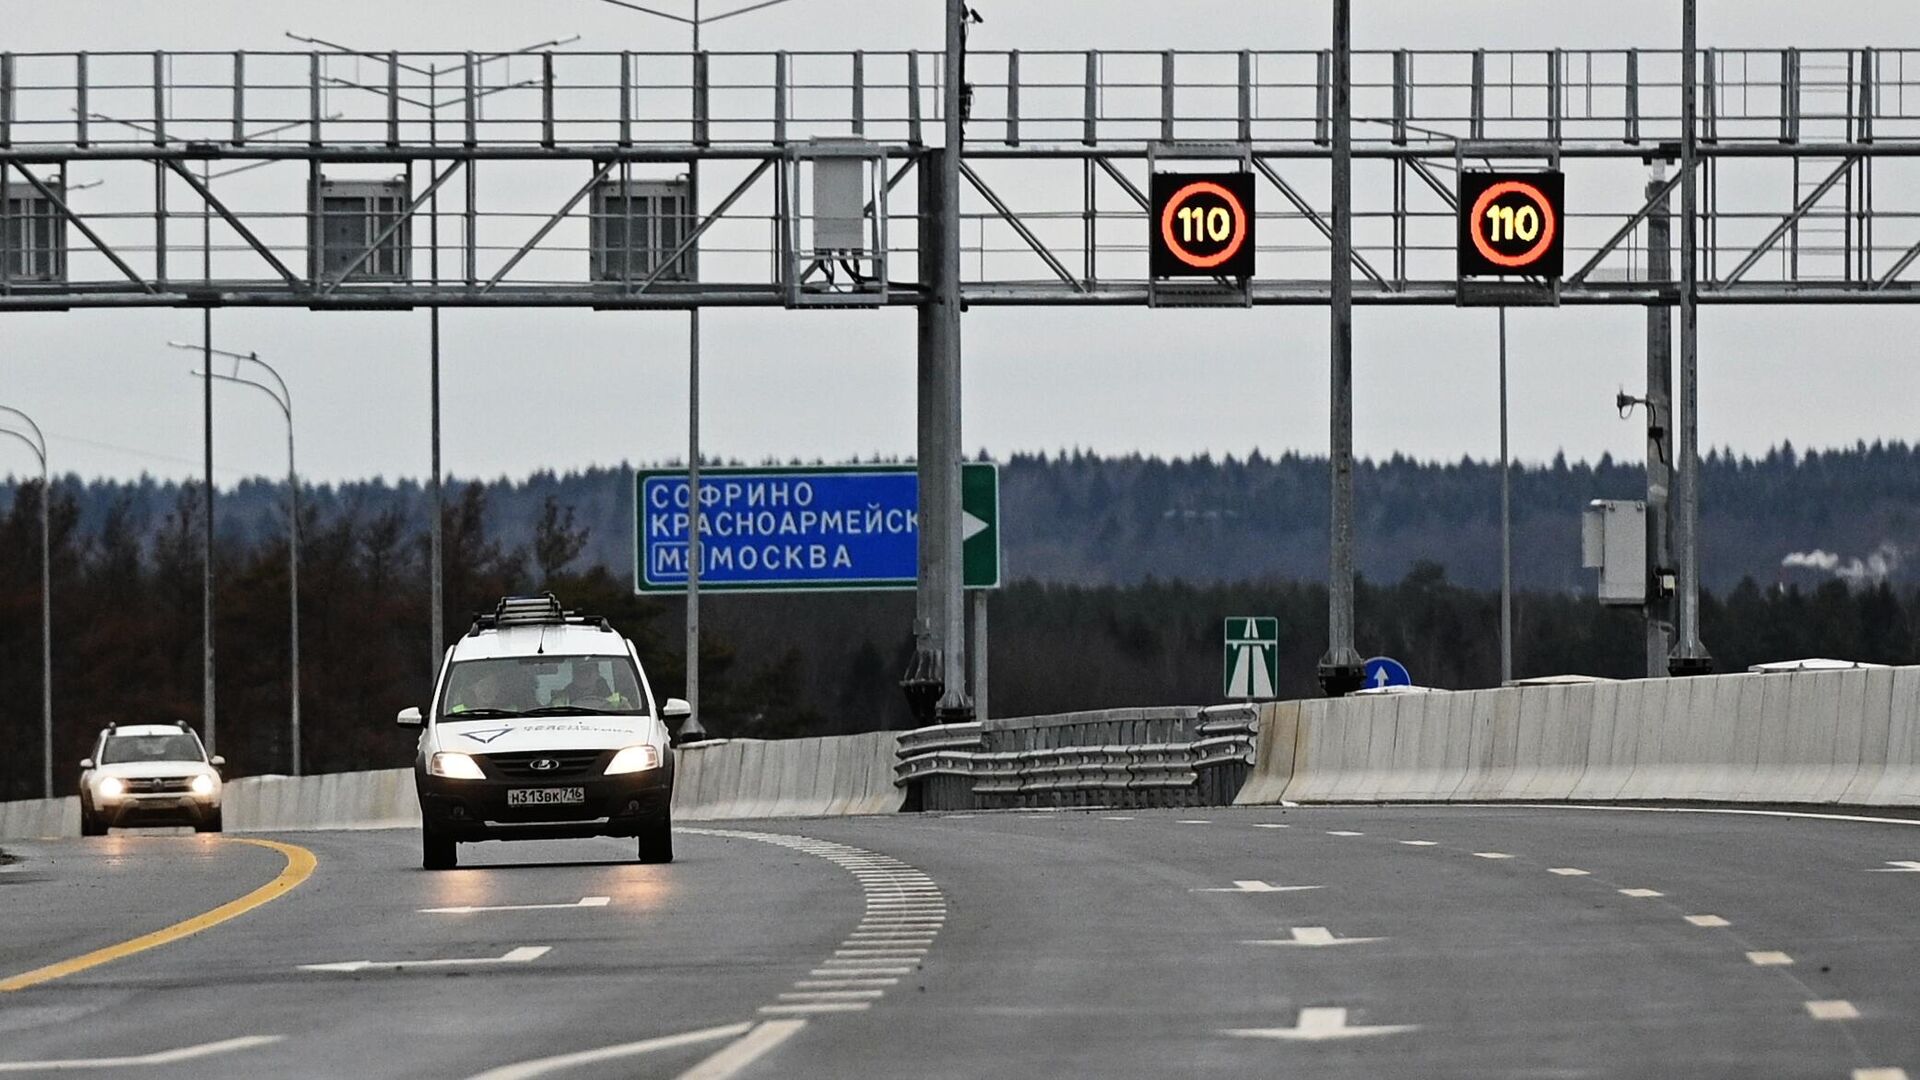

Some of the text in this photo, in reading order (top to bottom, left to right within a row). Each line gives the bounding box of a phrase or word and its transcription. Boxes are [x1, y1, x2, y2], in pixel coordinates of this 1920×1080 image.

[1177, 206, 1230, 242] 110
[1486, 204, 1539, 242] 110
[651, 481, 814, 508] СОФРИНО
[652, 502, 919, 537] КРАСНОАРМЕЙСК
[710, 543, 852, 571] МОСКВА
